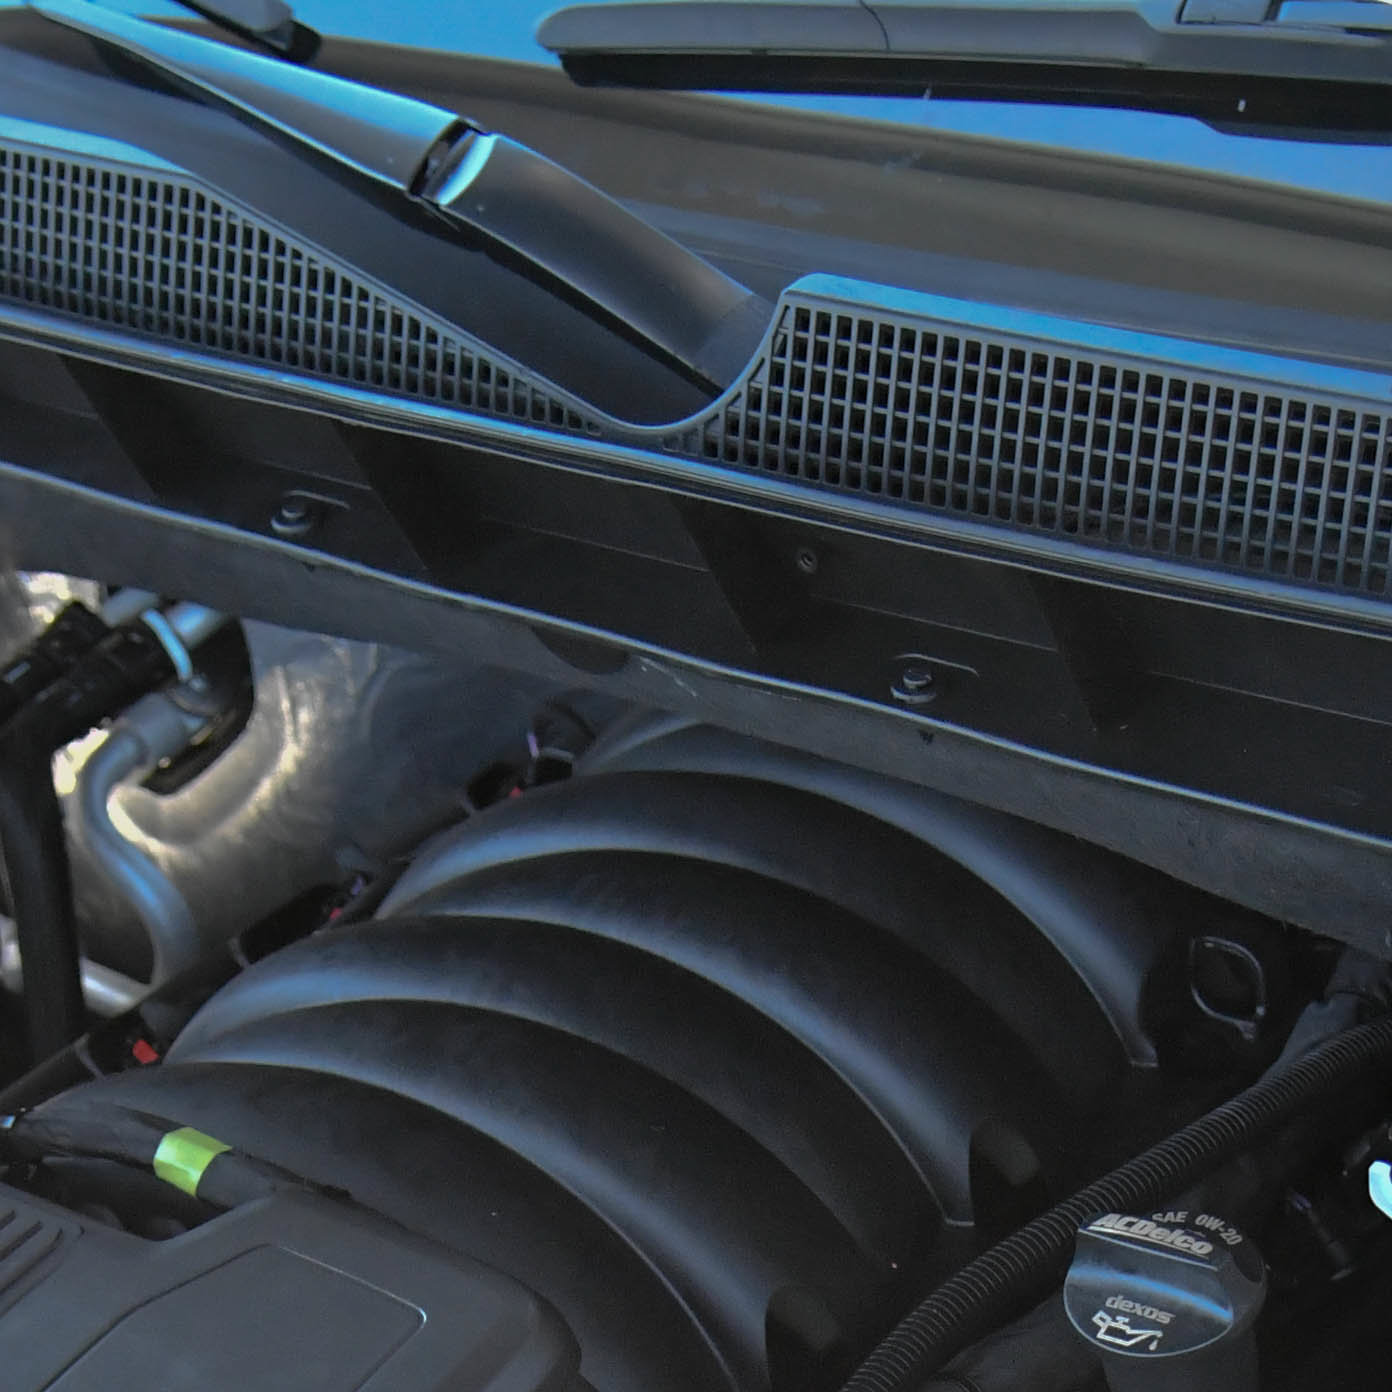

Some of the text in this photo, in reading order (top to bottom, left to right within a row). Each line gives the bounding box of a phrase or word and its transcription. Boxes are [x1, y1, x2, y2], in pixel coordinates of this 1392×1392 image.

[1090, 1213, 1214, 1256] ACDelco
[1152, 1211, 1243, 1245] SAE 0W-20
[1105, 1295, 1176, 1324] dexos
